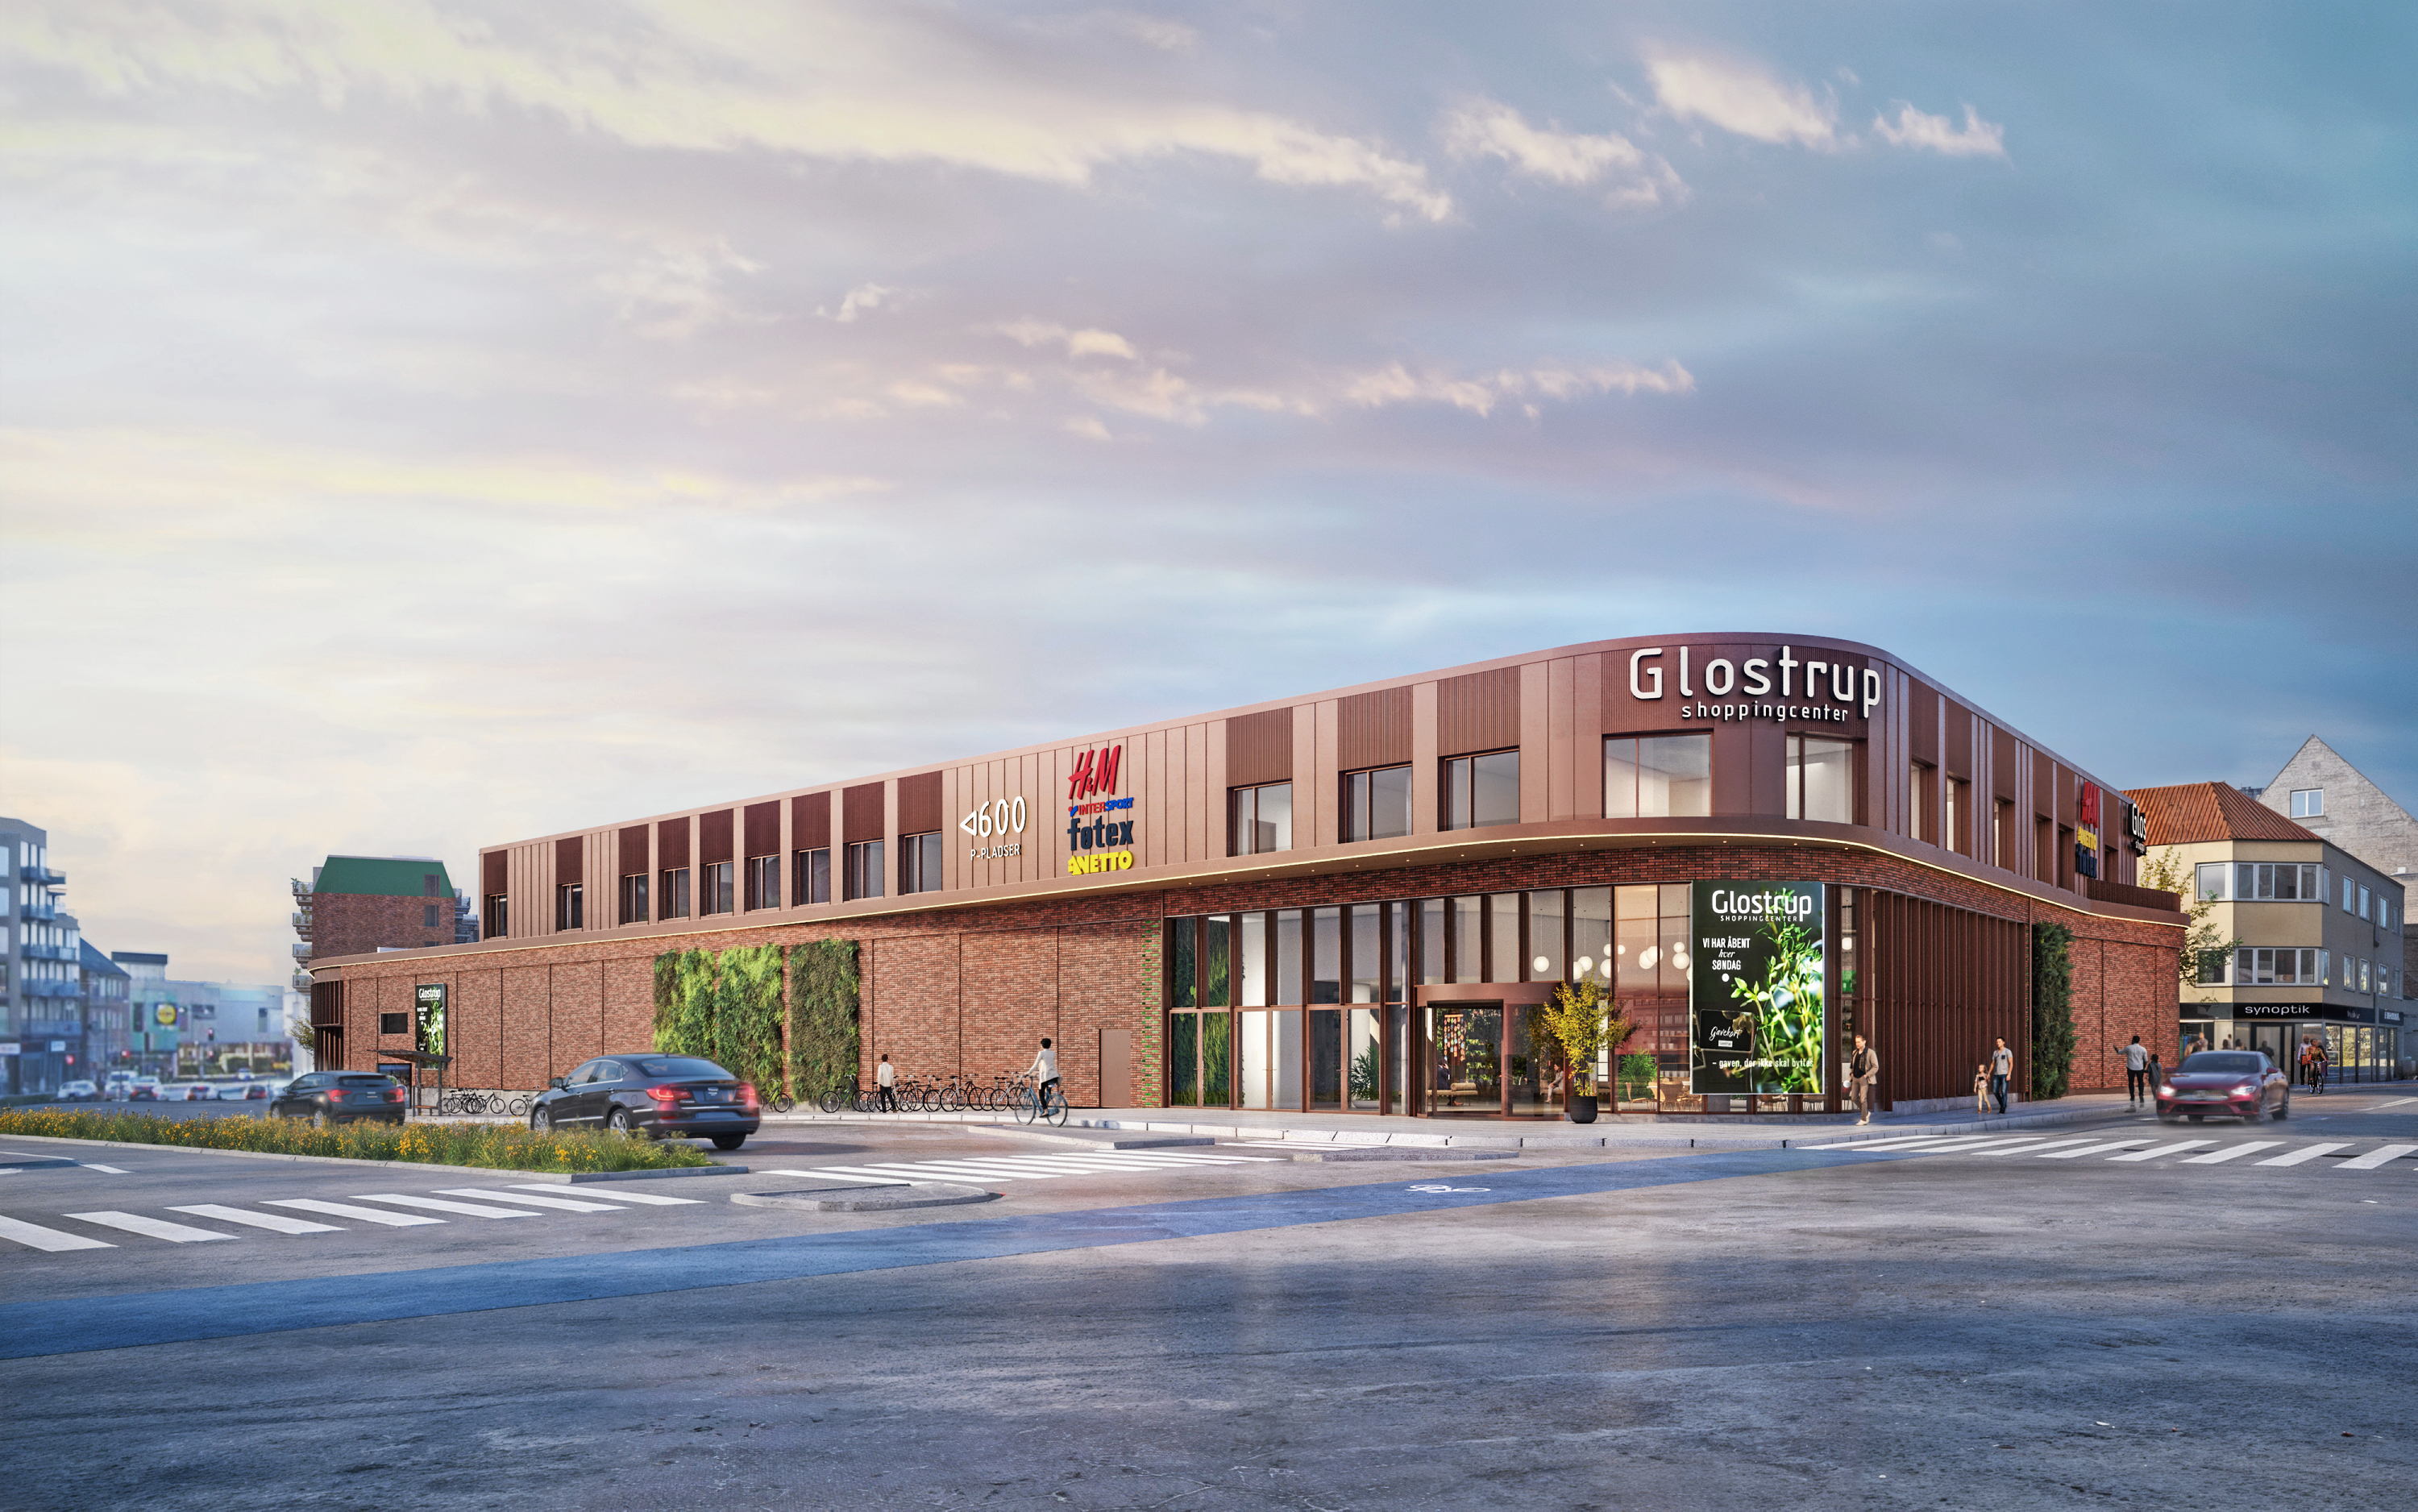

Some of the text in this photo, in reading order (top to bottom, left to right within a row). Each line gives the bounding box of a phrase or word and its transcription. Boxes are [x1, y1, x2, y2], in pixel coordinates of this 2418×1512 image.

[1630, 646, 1880, 718] Glostrup
[1682, 700, 1848, 722] shoppingcenter
[1068, 745, 1121, 800] H&M
[978, 795, 1027, 837] 600
[1078, 797, 1134, 815] INTERSPORT
[1067, 815, 1133, 850] føtex
[970, 843, 1021, 861] P-PLADSER
[1076, 850, 1134, 874] NETTO
[1712, 890, 1812, 922] Glostrup
[1702, 936, 1751, 948] VI HAR ÅBENT
[1712, 960, 1741, 970] SØNDAG
[2245, 1005, 2310, 1015] synoptik
[1709, 1026, 1743, 1041] Gavekort
[1744, 1058, 1756, 1067] der
[1775, 1058, 1789, 1067] skal
